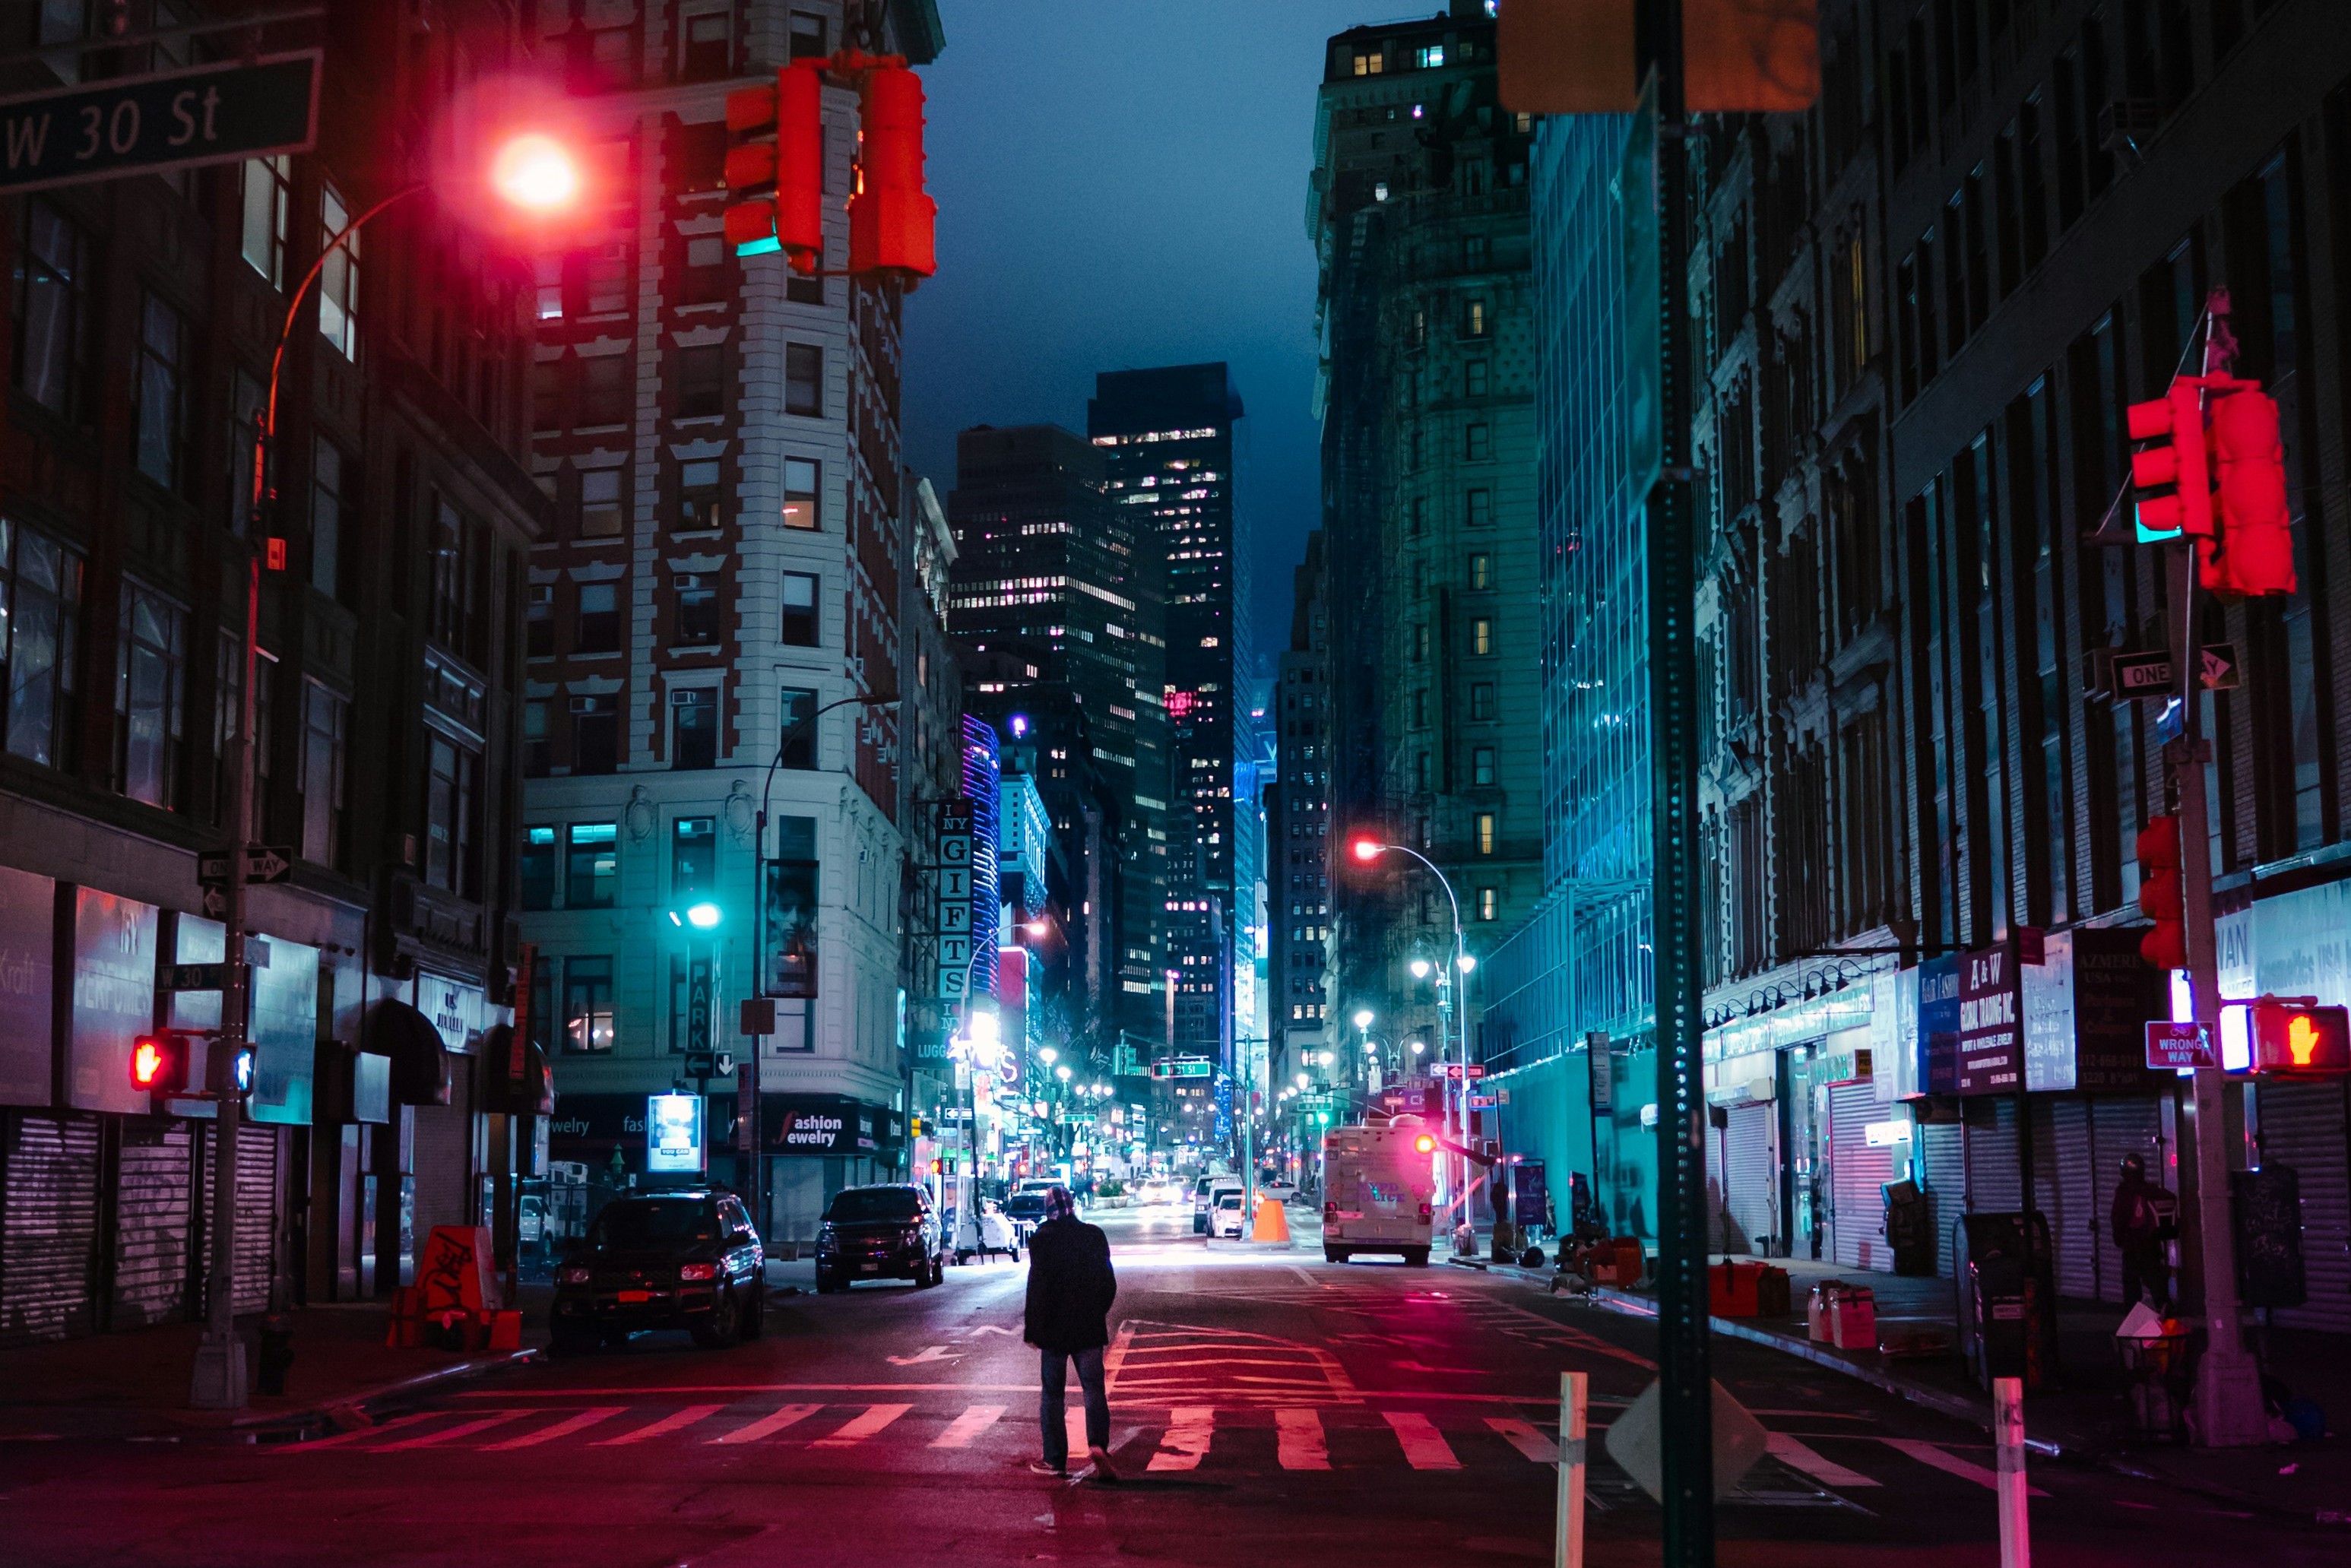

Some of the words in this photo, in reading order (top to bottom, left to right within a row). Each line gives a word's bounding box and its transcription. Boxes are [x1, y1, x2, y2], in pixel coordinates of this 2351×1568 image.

[7, 113, 49, 169] W
[76, 99, 142, 160] 30
[169, 84, 222, 147] St
[2133, 666, 2169, 684] ONE
[943, 817, 968, 830] NY
[211, 860, 230, 874] ON
[252, 858, 280, 873] WAY
[943, 840, 968, 993] GIFTS
[161, 969, 174, 988] W
[181, 968, 202, 987] 30
[1970, 959, 1979, 991] A
[1981, 960, 1988, 984] &
[1989, 952, 2001, 985] W
[2085, 972, 2112, 984] USA
[692, 965, 706, 1049] PARK
[1960, 999, 1979, 1032] GLOBAL
[1979, 993, 2002, 1028] TRADING
[917, 1044, 947, 1058] LUGG
[2159, 1039, 2202, 1050] WRONG
[2168, 1051, 2194, 1063] WAY
[550, 1117, 590, 1137] welry
[1358, 1182, 1399, 1192] NYPD
